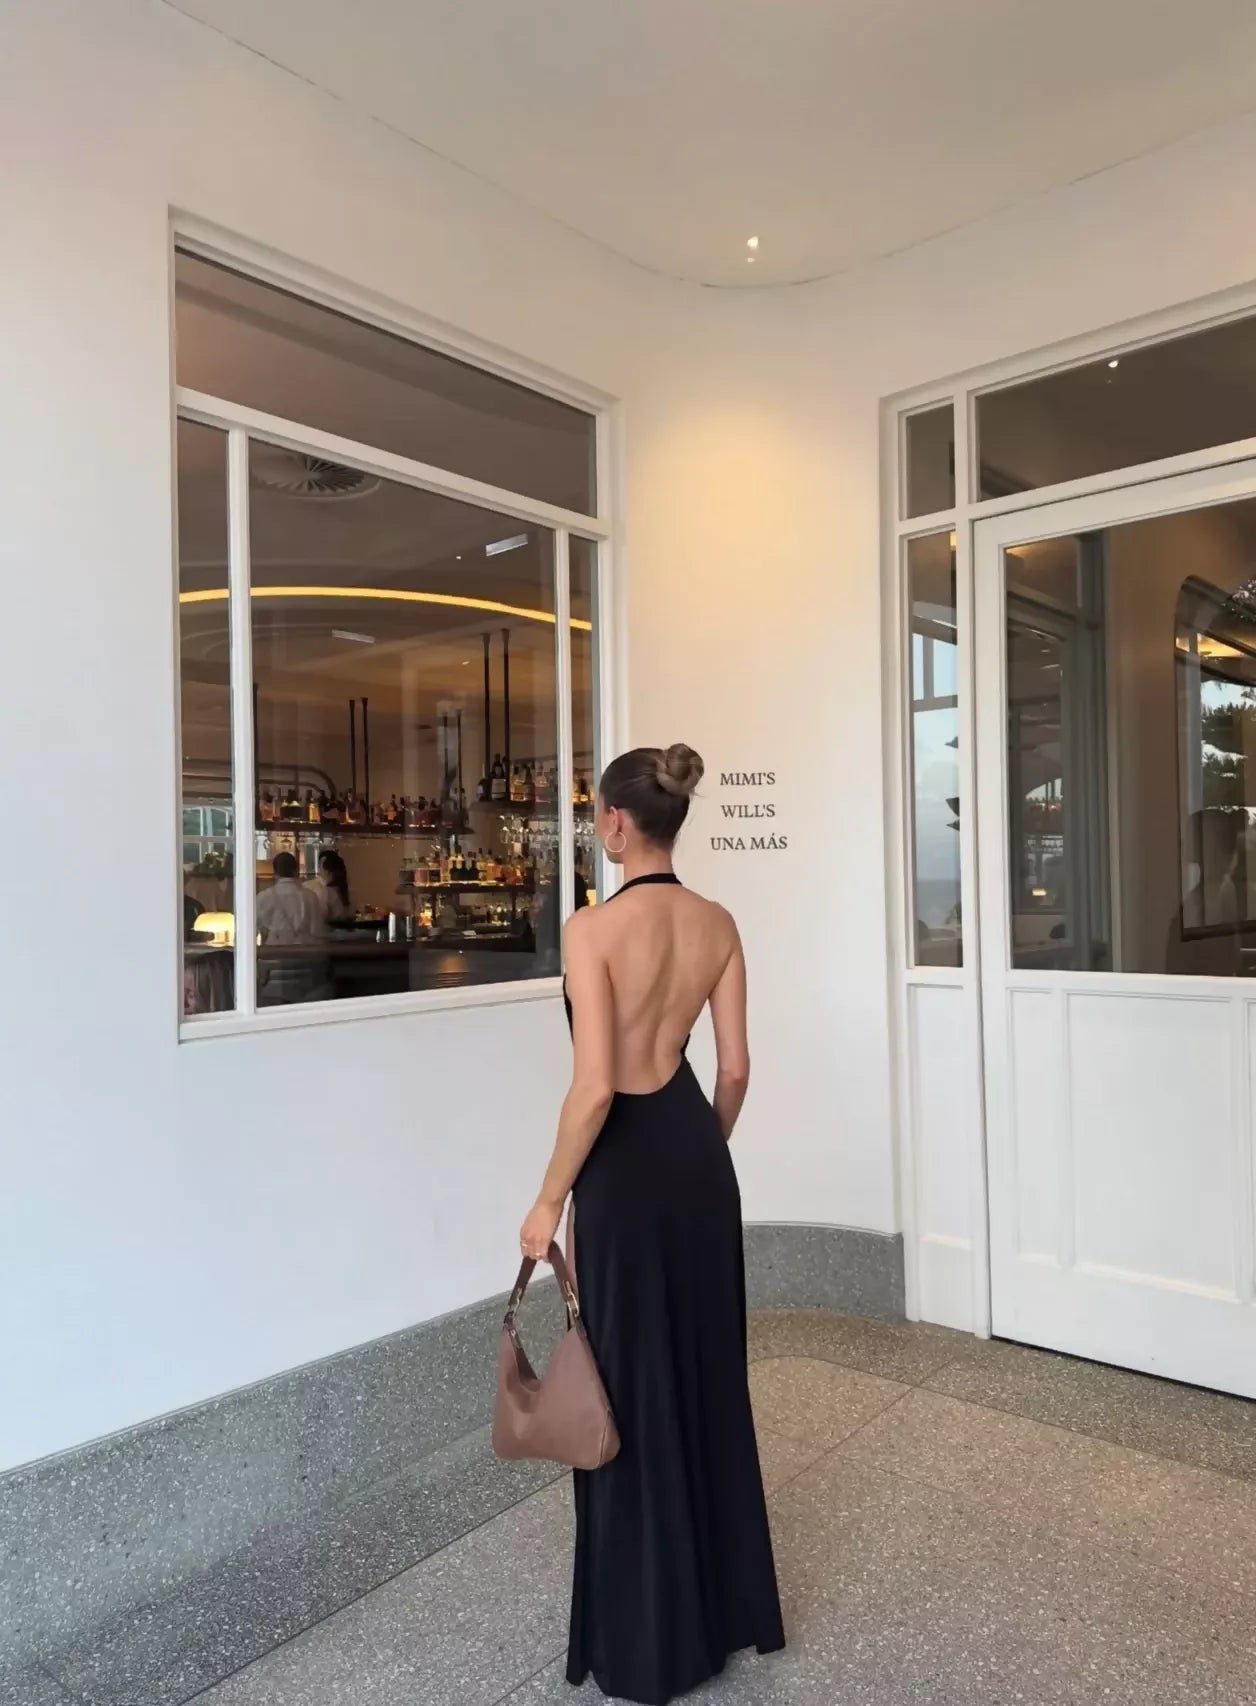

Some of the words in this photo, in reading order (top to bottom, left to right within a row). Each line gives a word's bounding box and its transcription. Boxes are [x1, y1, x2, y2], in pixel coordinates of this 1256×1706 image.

[720, 772, 776, 786] MIMI'S
[720, 804, 776, 818] WILL'S
[710, 837, 746, 850] UNA
[750, 833, 788, 850] MÁS
